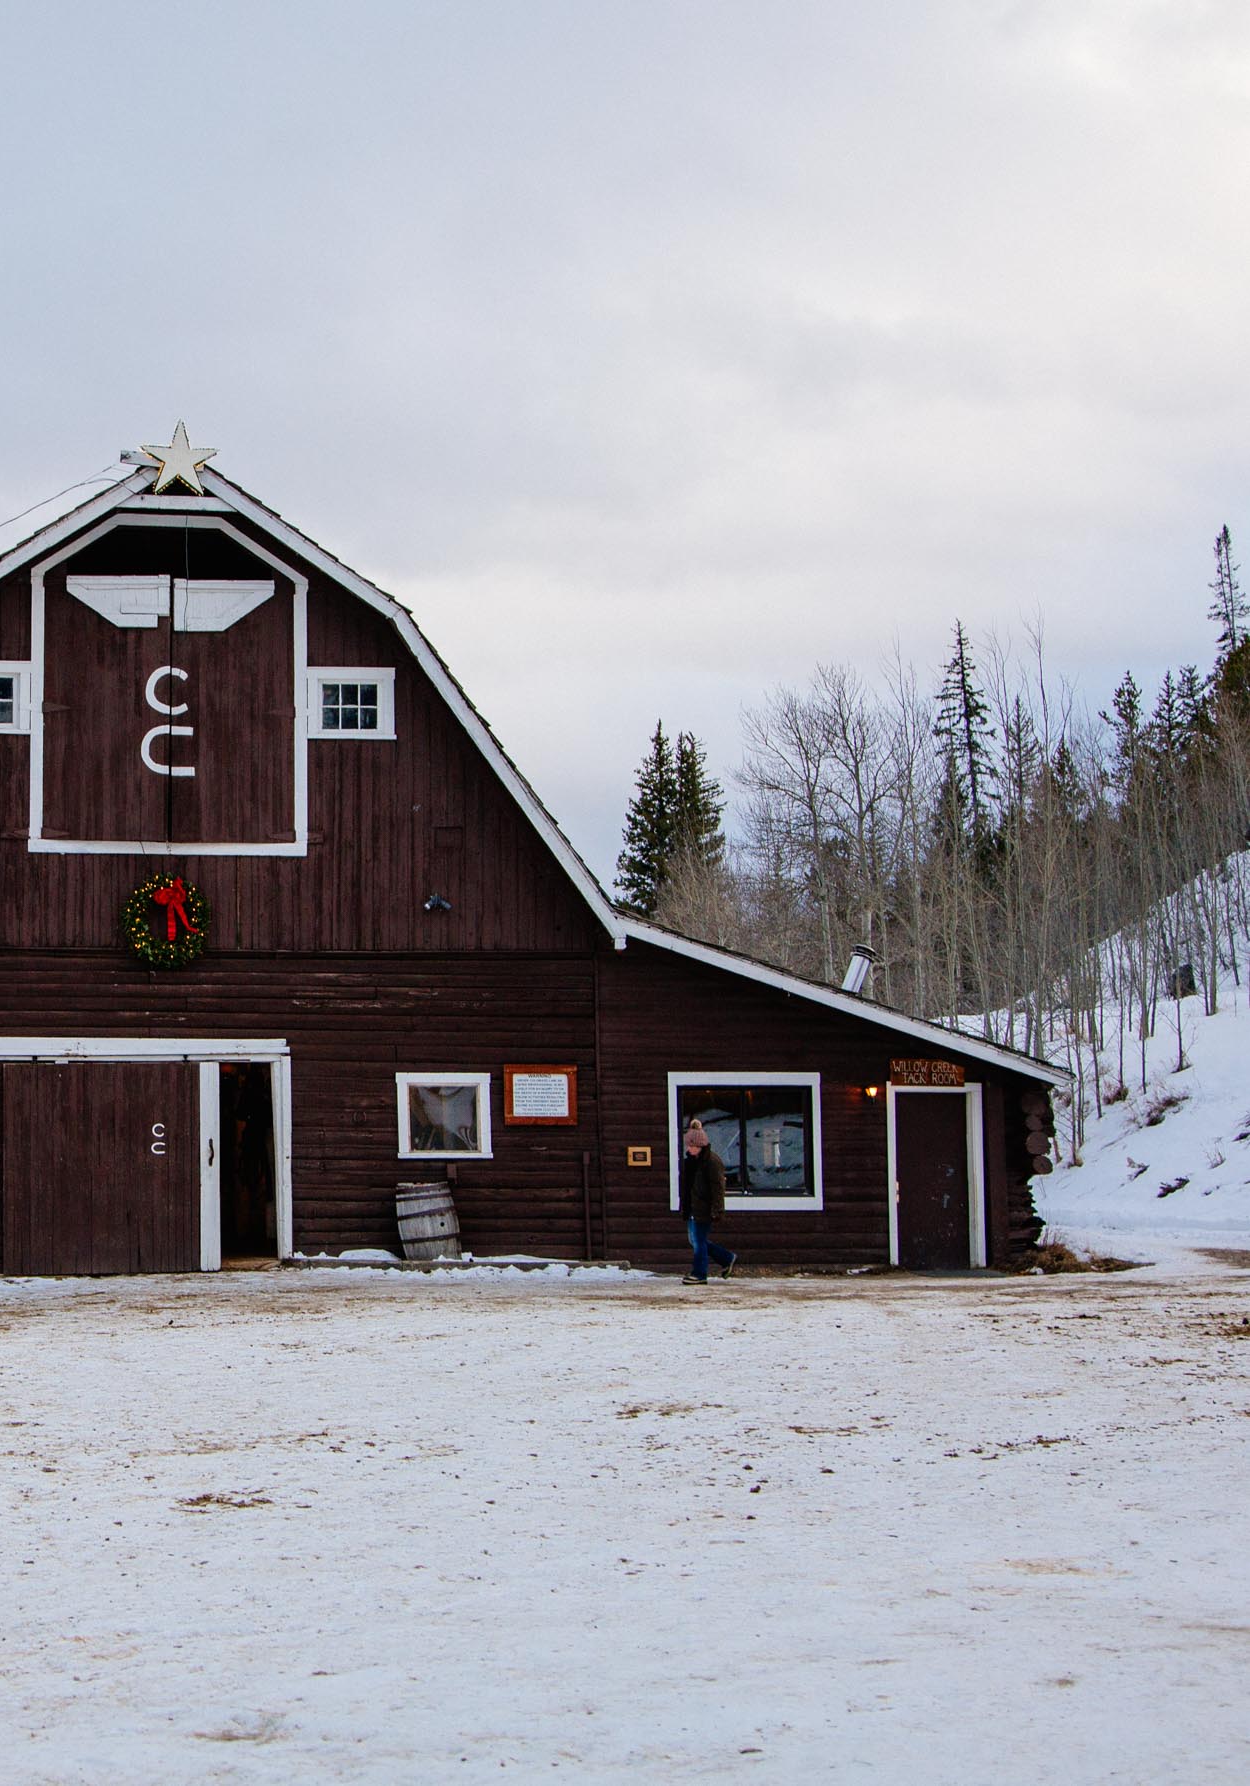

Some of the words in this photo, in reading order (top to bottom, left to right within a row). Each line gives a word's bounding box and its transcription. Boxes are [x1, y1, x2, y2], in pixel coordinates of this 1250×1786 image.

[145, 665, 189, 716] C
[892, 1060, 928, 1073] WILLOW
[931, 1061, 958, 1073] CREEK
[902, 1072, 927, 1084] TACK
[931, 1072, 958, 1085] ROOM
[152, 1123, 165, 1137] C
